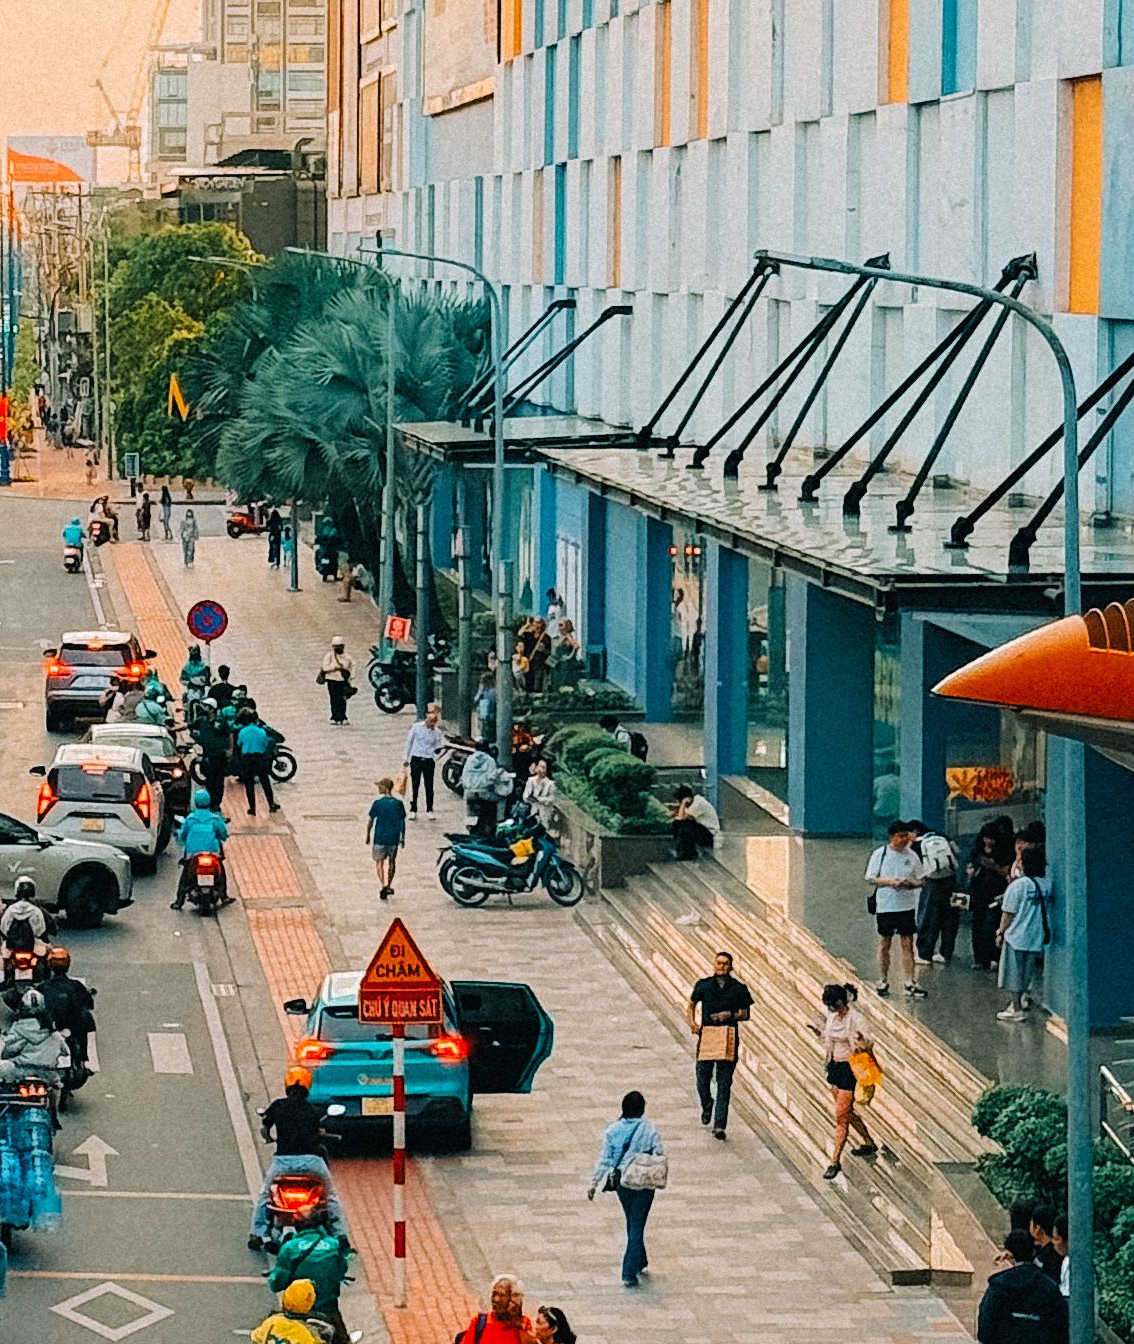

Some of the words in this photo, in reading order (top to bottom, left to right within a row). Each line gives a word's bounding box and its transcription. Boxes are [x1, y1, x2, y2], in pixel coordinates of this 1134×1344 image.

[390, 944, 406, 958] ĐI
[363, 996, 381, 1018] CHÚ
[383, 996, 390, 1017] Ý
[392, 1000, 417, 1018] QUAN
[419, 995, 437, 1018] SÁT
